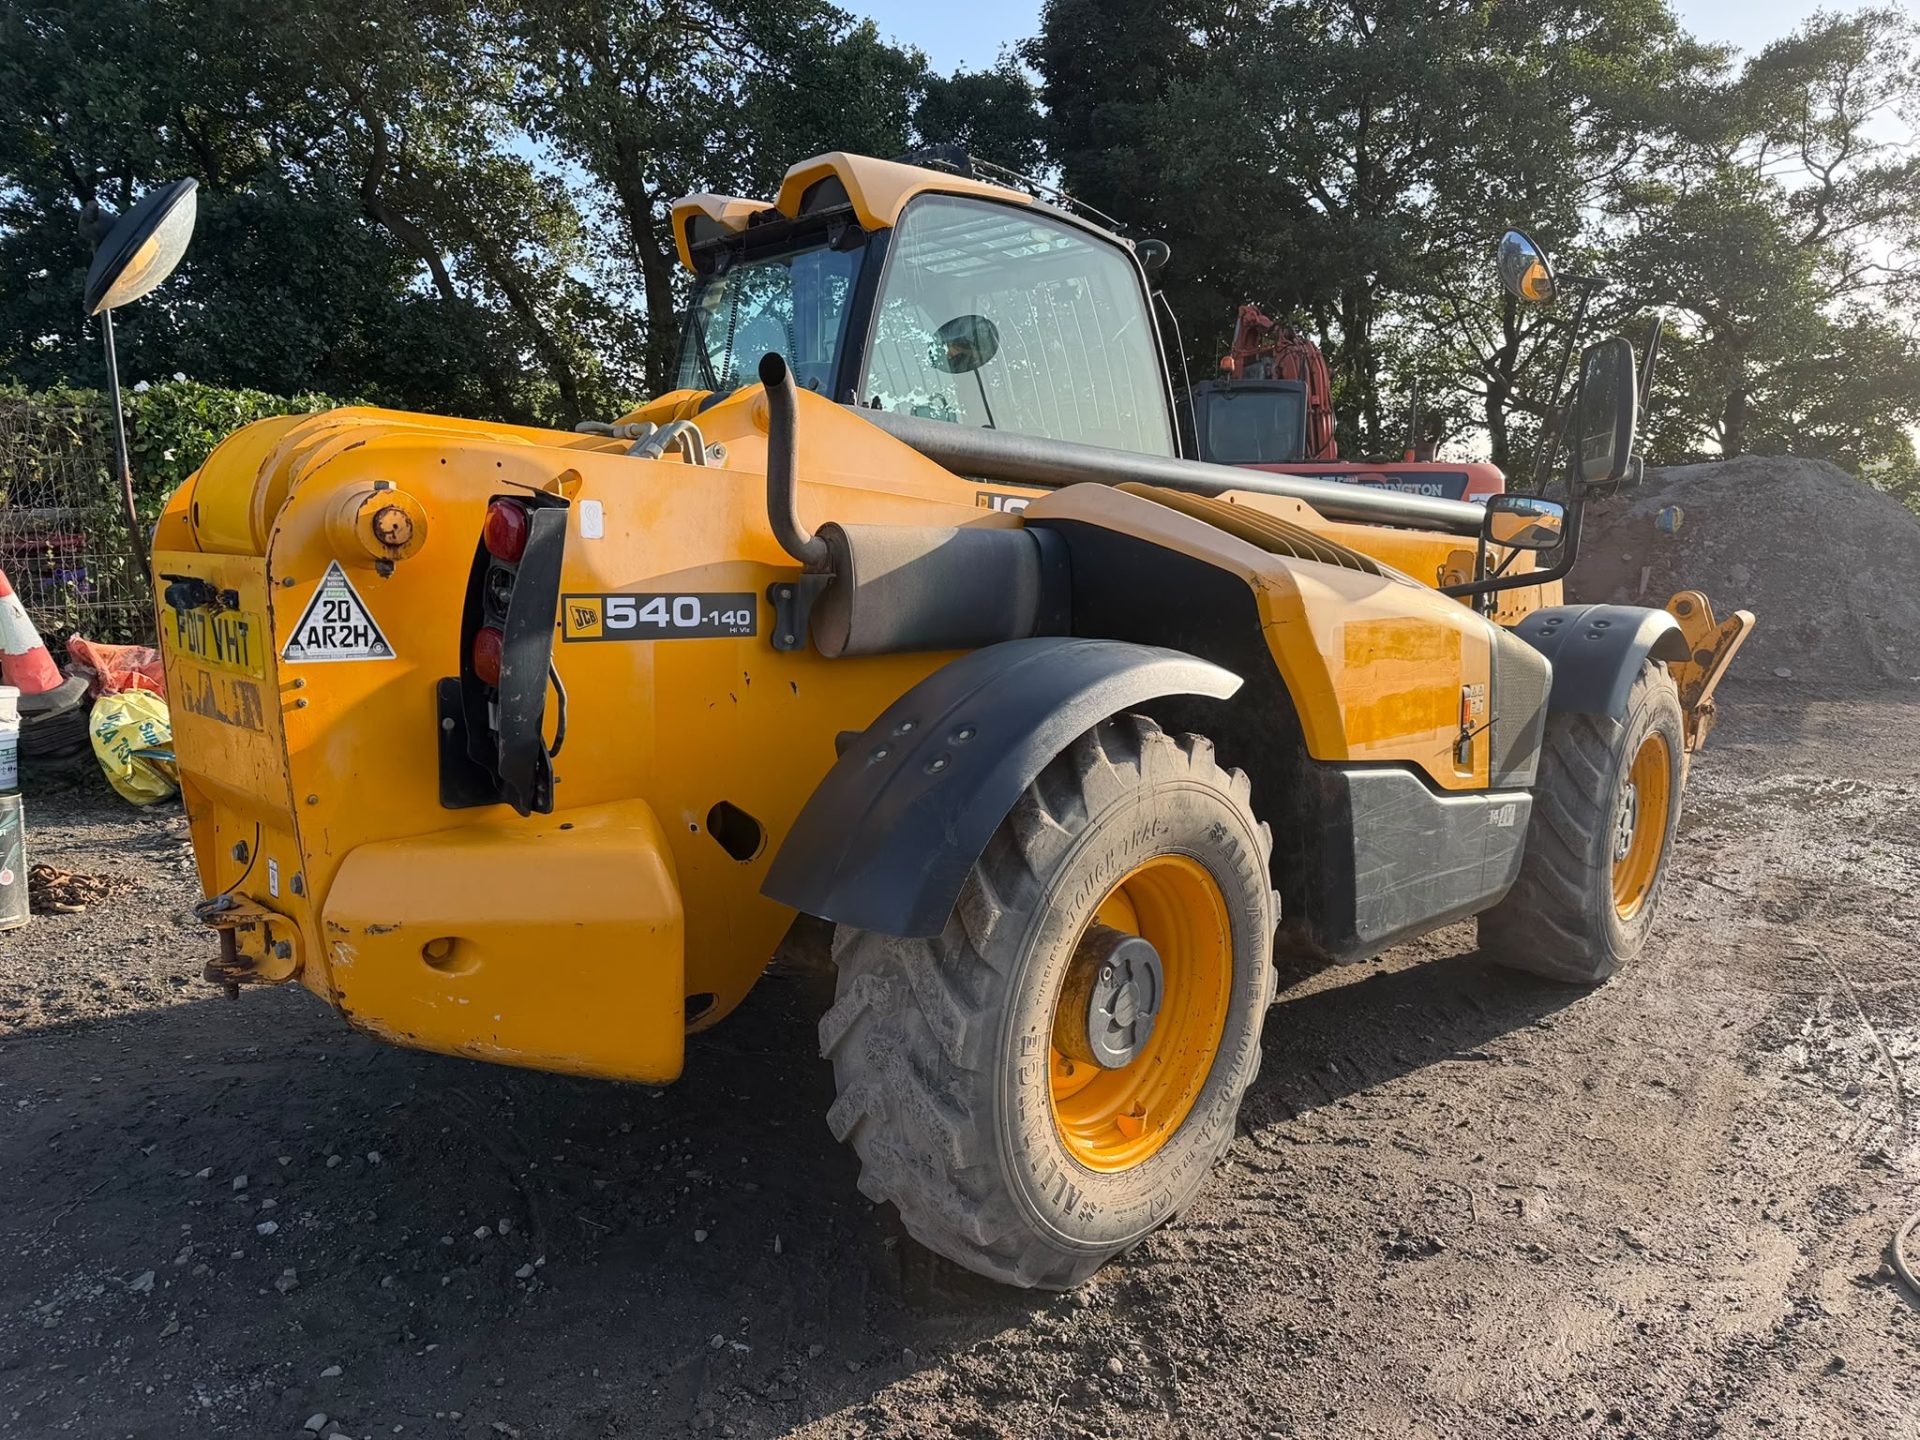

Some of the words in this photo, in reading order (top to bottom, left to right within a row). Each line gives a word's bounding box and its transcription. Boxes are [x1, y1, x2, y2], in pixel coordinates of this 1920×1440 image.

[307, 625, 369, 649] AR2H
[606, 596, 750, 629] 540-140
[209, 616, 249, 667] VHT
[1216, 835, 1265, 1002] ALLIANCE
[1018, 1034, 1083, 1216] ALLIANCE
